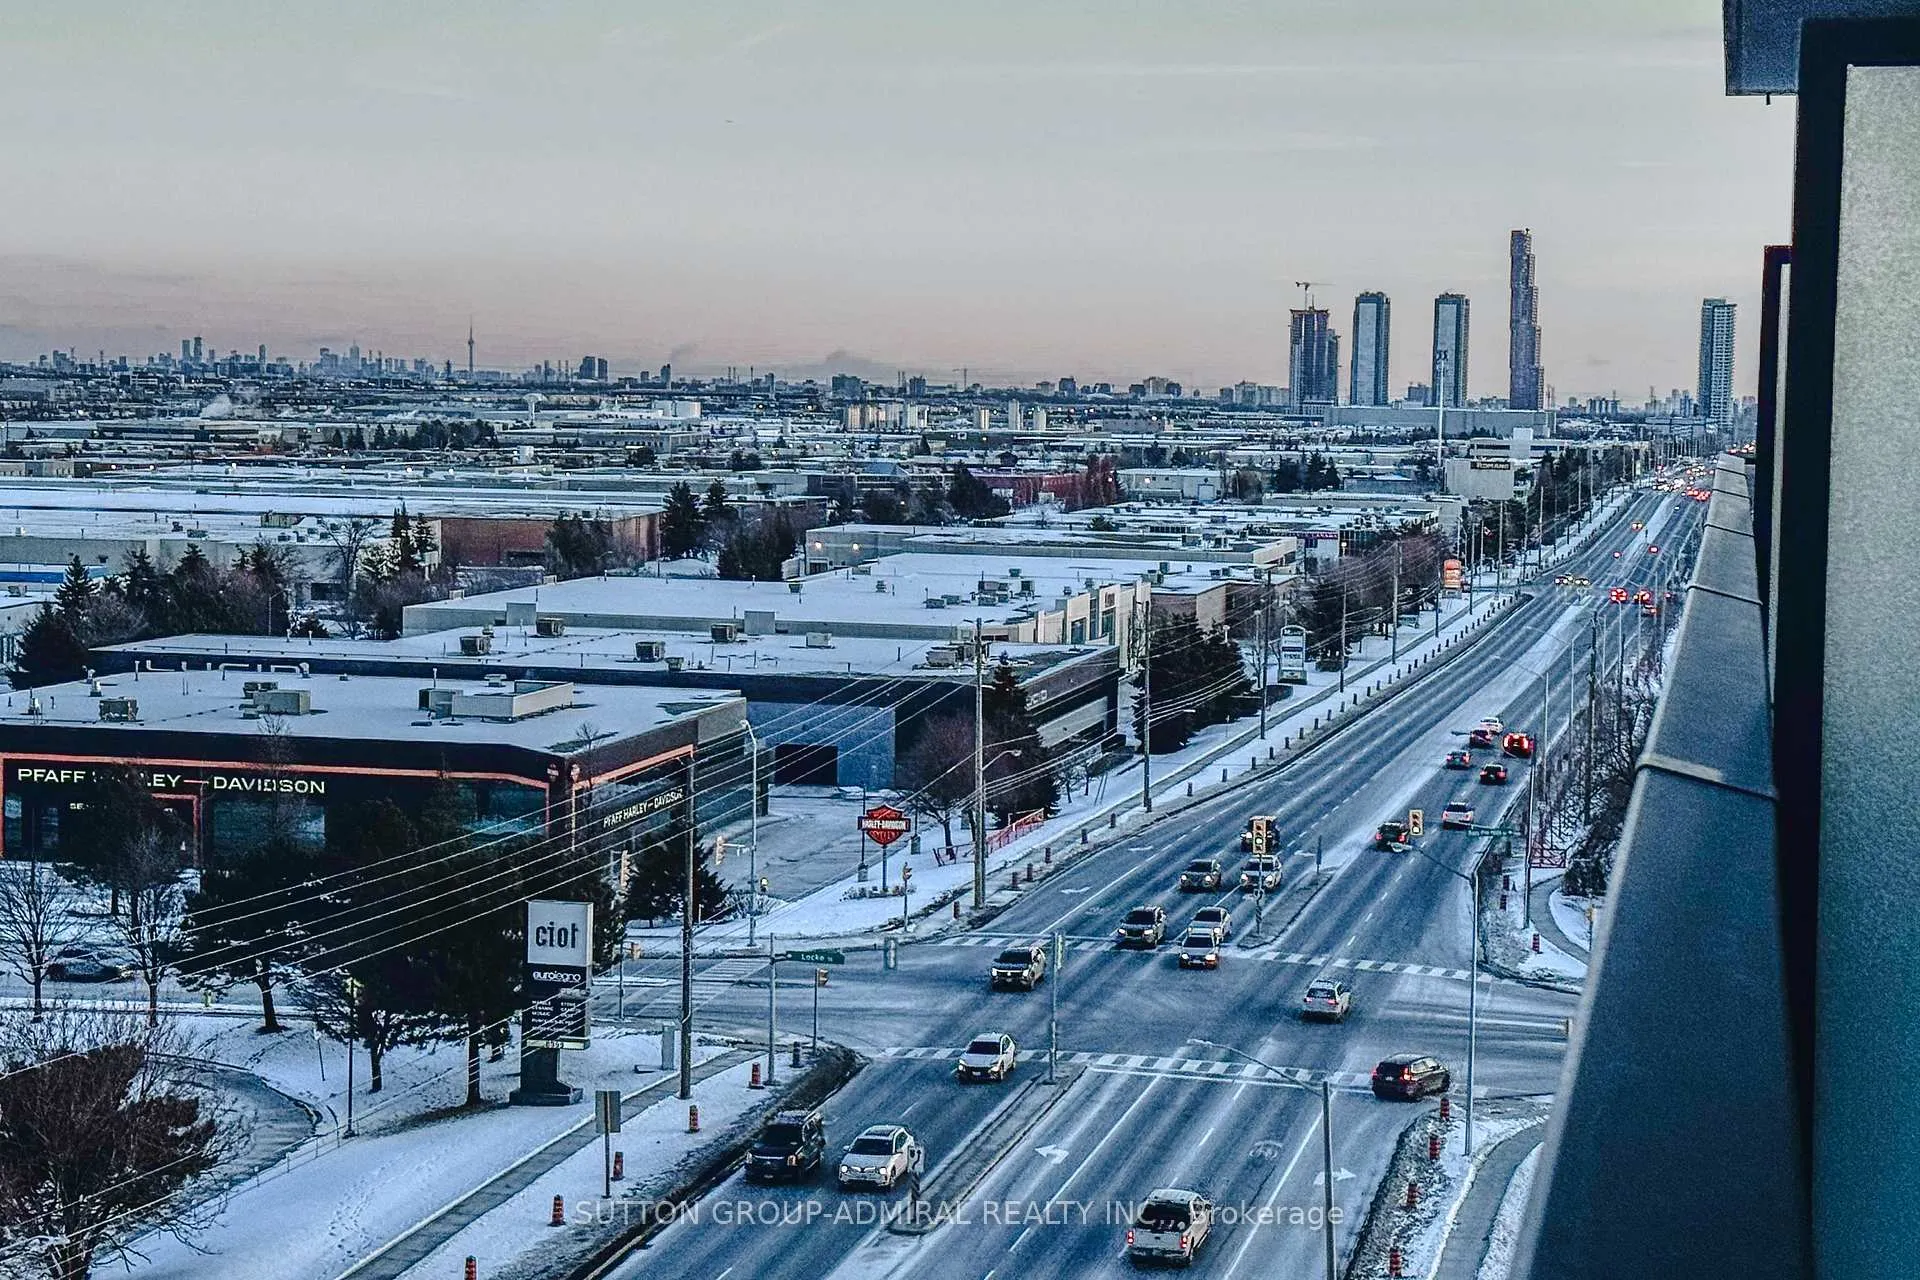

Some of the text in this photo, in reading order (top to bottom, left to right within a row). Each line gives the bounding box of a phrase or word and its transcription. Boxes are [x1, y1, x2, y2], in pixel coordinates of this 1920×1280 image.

[17, 768, 86, 783] PFAFF
[213, 776, 325, 794] DAVIDSON
[623, 801, 648, 820] HARLEY
[535, 921, 579, 949] ciot
[800, 953, 825, 962] Locke
